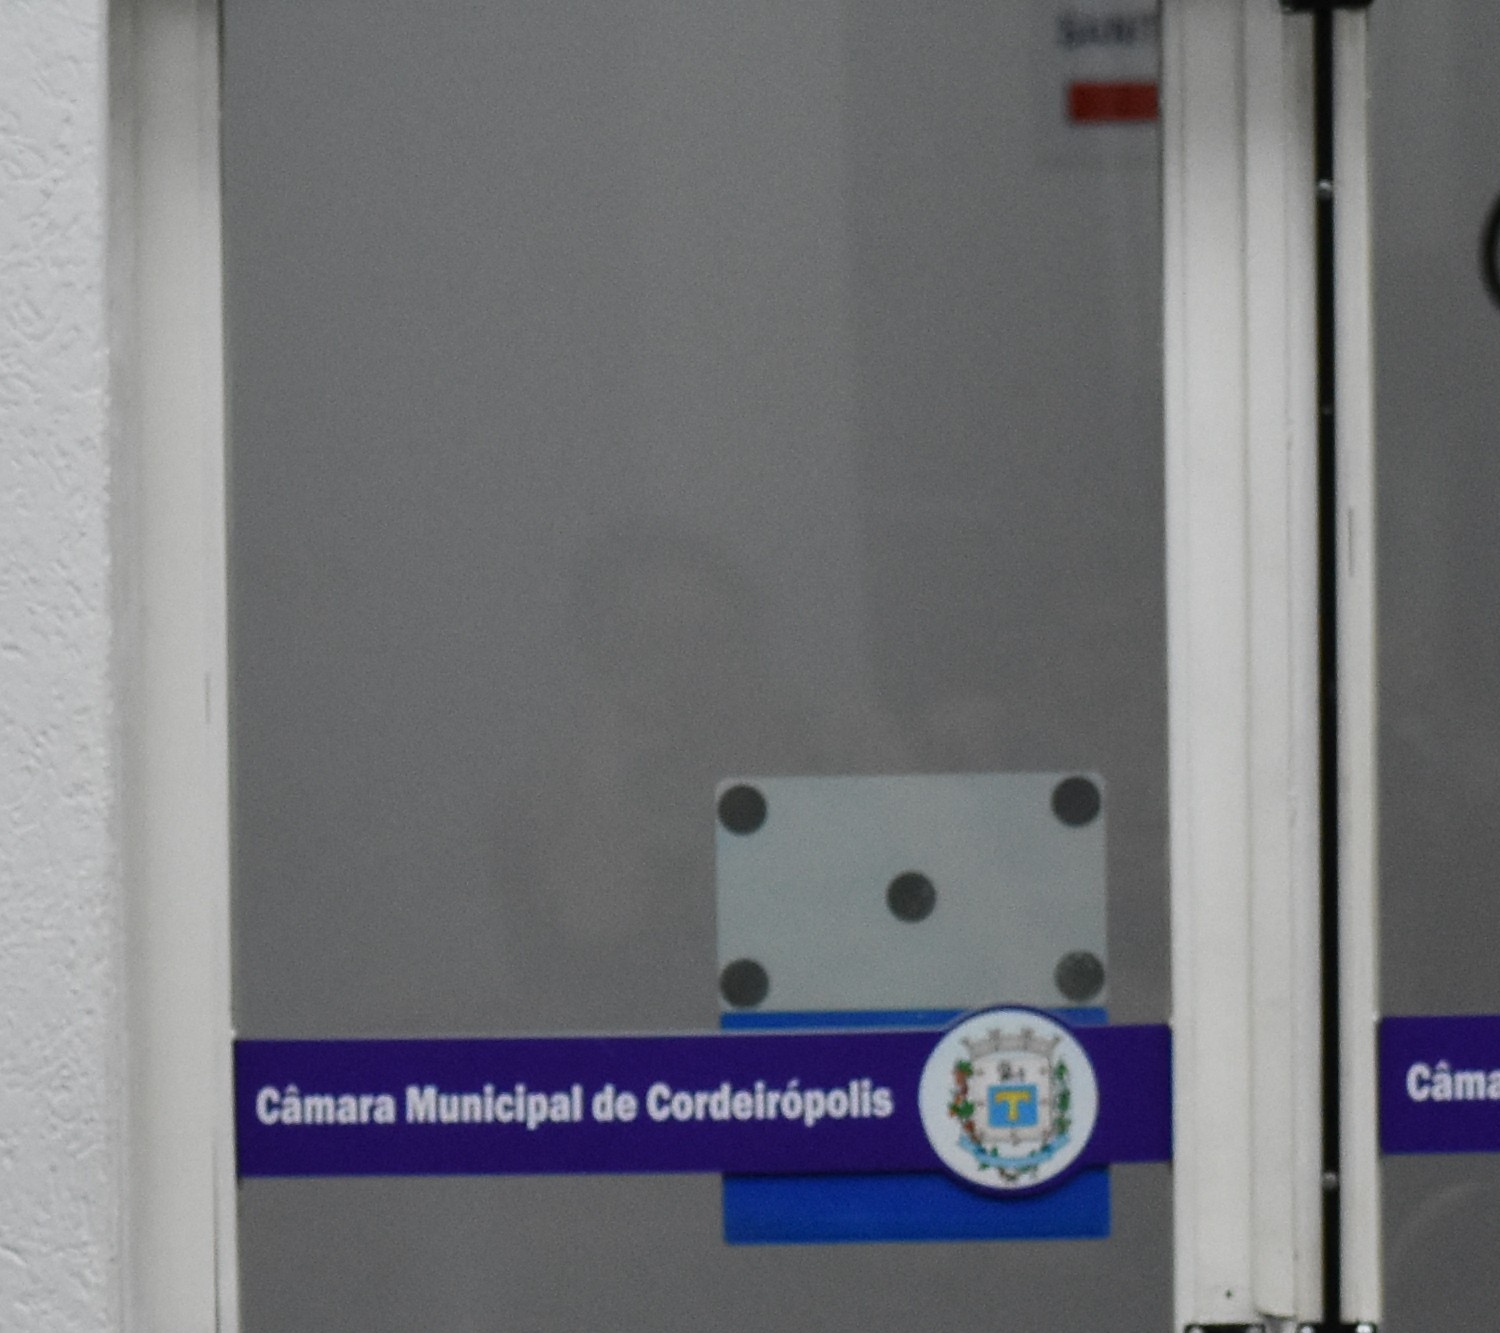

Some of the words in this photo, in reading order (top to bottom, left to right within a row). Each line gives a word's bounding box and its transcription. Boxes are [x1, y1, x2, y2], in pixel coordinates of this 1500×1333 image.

[256, 1084, 396, 1125] Câmara
[405, 1083, 584, 1131] Municipal
[591, 1083, 638, 1122] de
[647, 1078, 895, 1127] Cordeirópolis
